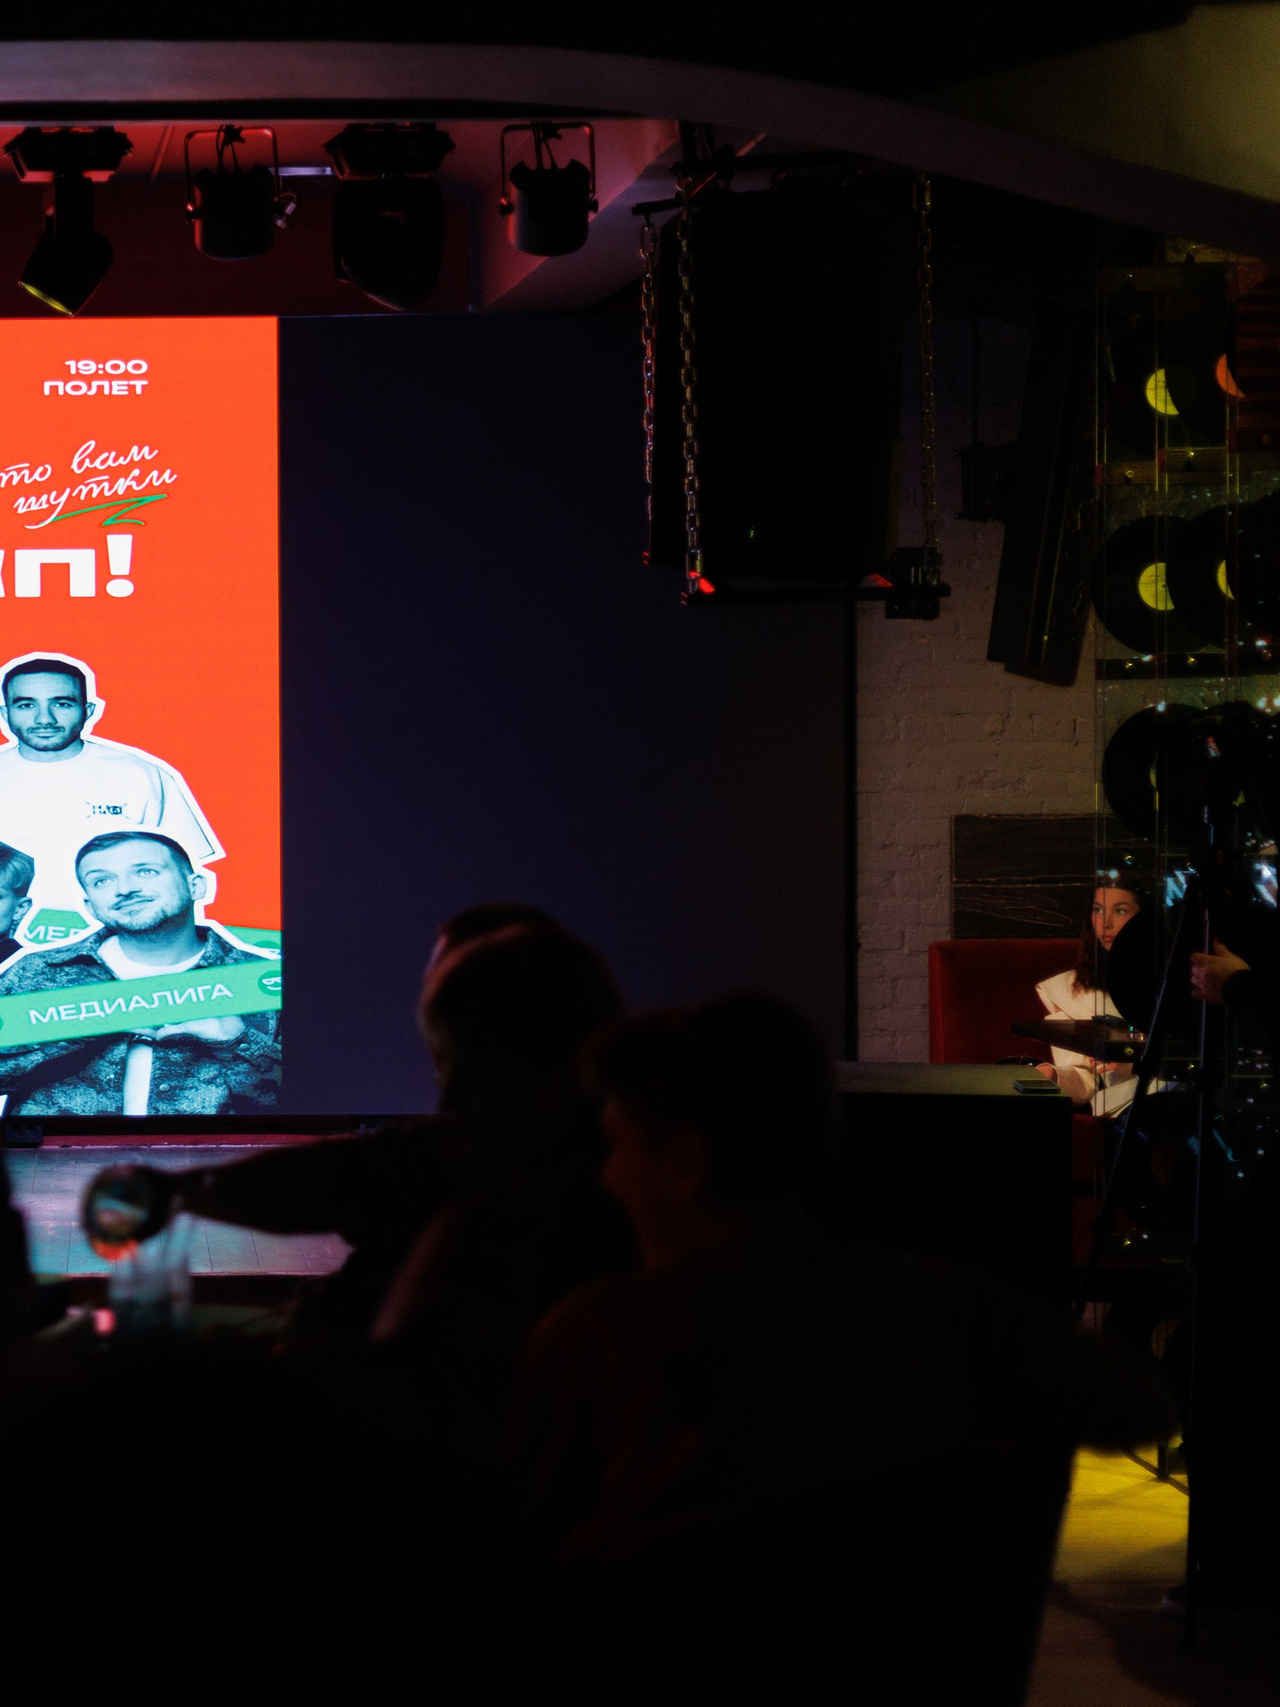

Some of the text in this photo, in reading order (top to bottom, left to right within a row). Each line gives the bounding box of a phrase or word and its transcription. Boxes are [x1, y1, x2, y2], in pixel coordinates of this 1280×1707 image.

[64, 359, 148, 375] 19:00
[43, 379, 149, 396] ПОЛЕТ
[70, 439, 159, 474] вам
[12, 468, 178, 530] шутки
[29, 984, 234, 1024] МЕДИАЛИГА
